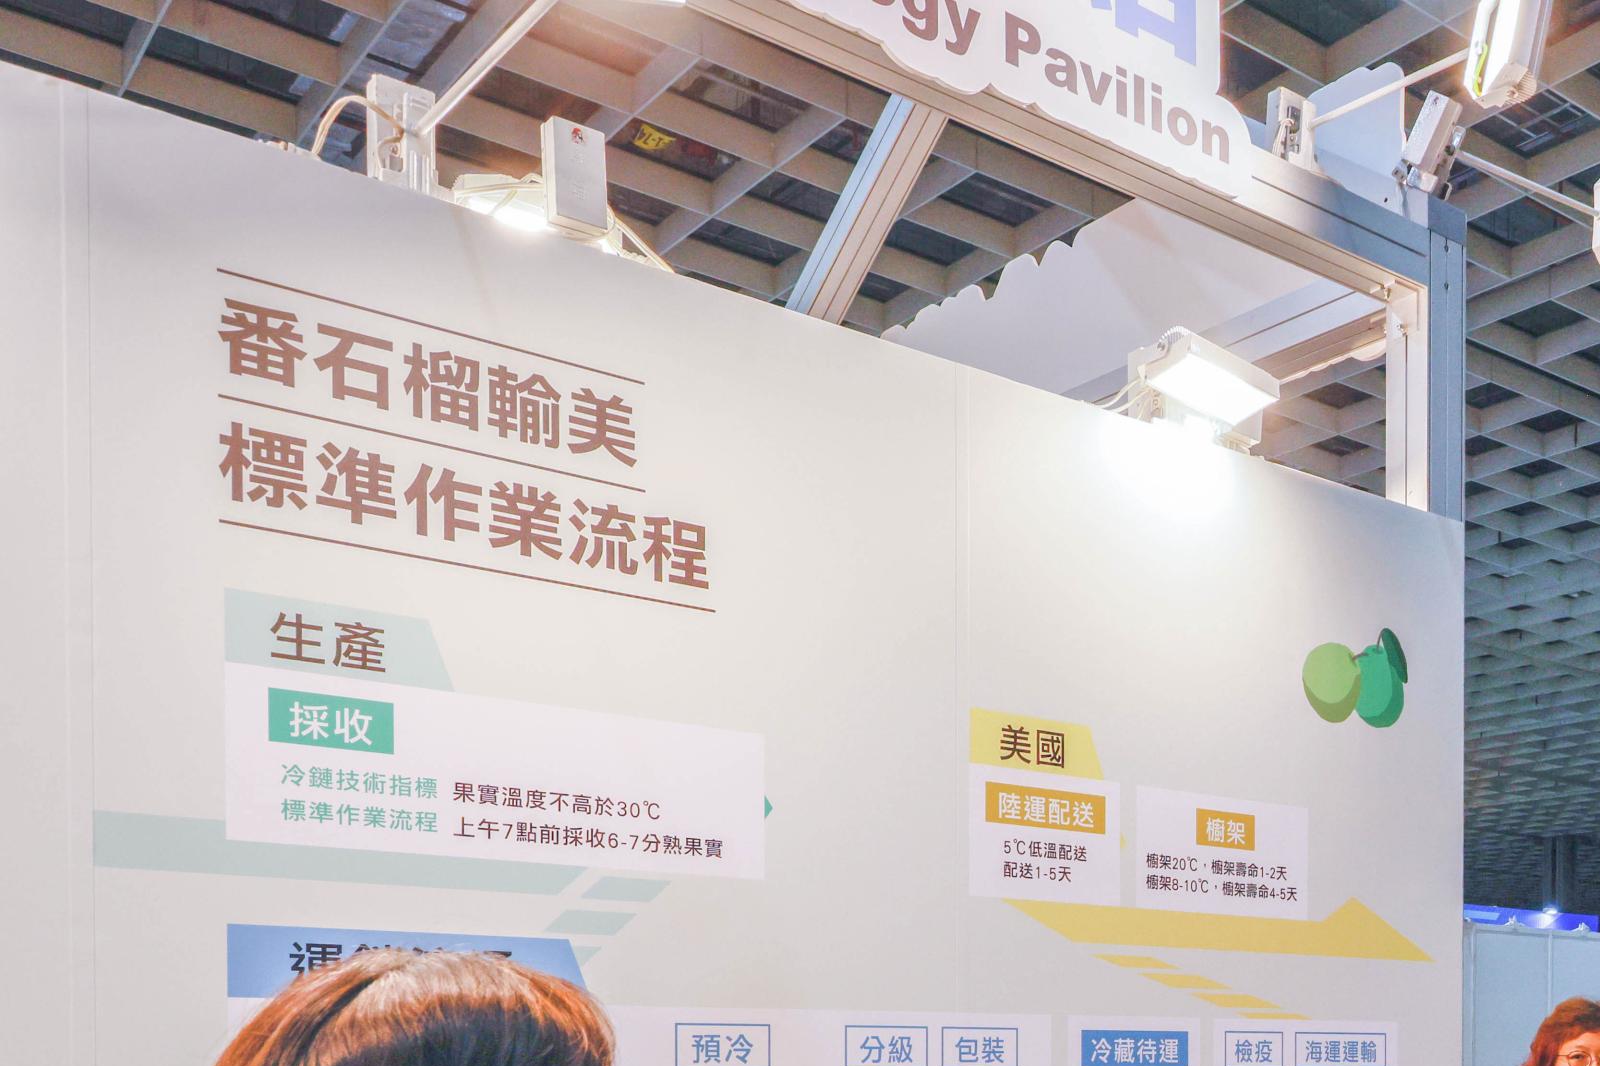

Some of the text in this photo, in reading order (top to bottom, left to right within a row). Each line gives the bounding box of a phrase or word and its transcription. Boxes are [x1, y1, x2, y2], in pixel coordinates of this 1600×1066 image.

[1004, 11, 1230, 165] Pavilion
[217, 297, 637, 468] 番石榴輸美
[218, 421, 710, 590] 標準作業流程
[269, 611, 387, 673] 生產
[288, 701, 373, 746] 採收
[1000, 724, 1066, 769] 美國
[280, 763, 438, 800] 冷鏈技術指標
[280, 799, 438, 834] 標準作業流程
[998, 791, 1095, 829] 陸運配送
[452, 816, 724, 859] 上午7點前採收6-7分熟果實
[1205, 816, 1246, 846] 櫥架
[1003, 861, 1072, 883] 配送1-5天
[691, 1033, 755, 1065] 預冷
[860, 1035, 914, 1065] 分級
[954, 1036, 1005, 1065] 包裝
[1090, 1037, 1180, 1064] 冷藏待運
[1234, 1039, 1273, 1064] 檢疫
[1304, 1039, 1377, 1065] 海運運輸
